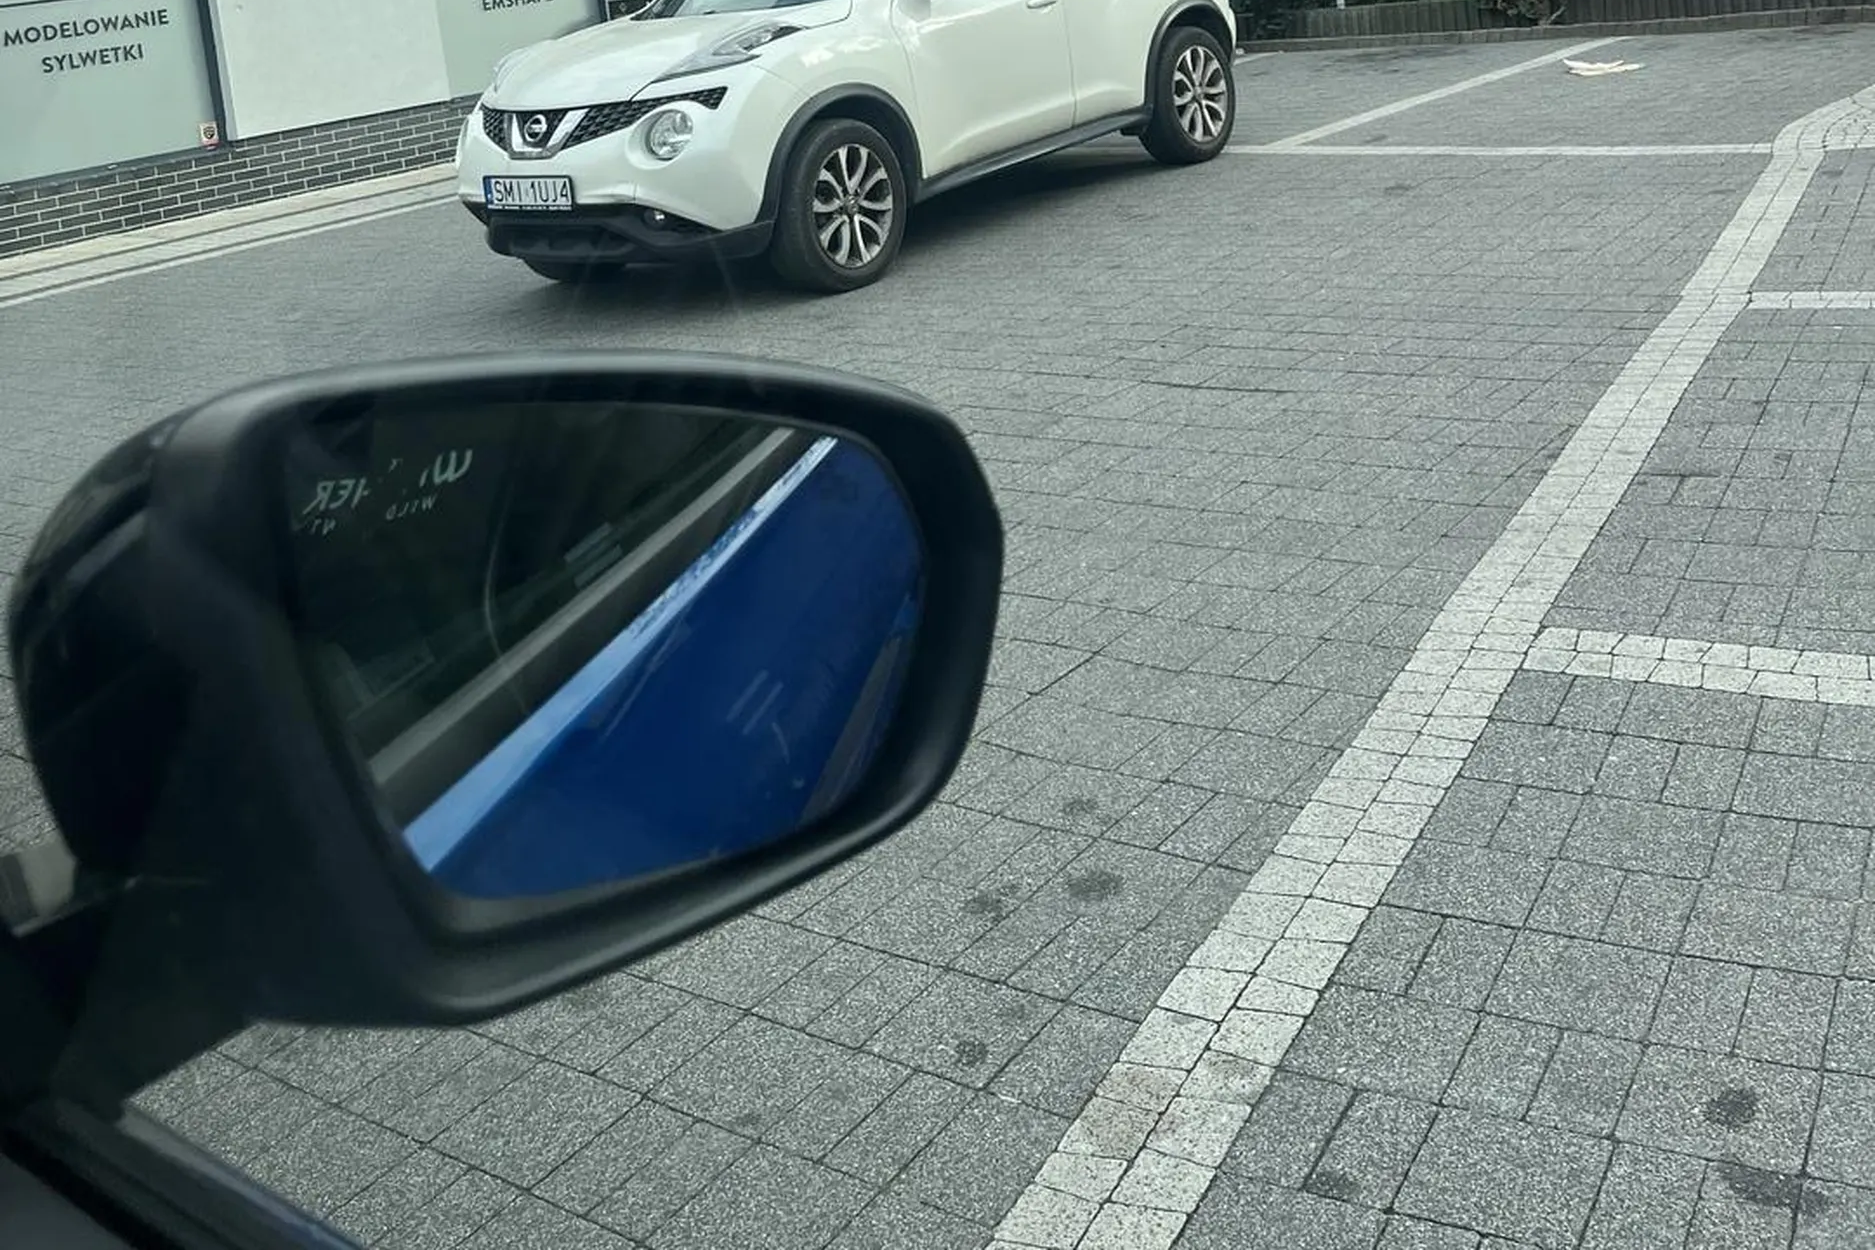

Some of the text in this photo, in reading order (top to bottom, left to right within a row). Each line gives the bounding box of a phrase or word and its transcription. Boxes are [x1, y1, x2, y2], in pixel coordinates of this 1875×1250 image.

[3, 9, 170, 47] MODELOWANIE
[41, 43, 144, 74] SYLWETKI
[494, 180, 522, 203] SMI
